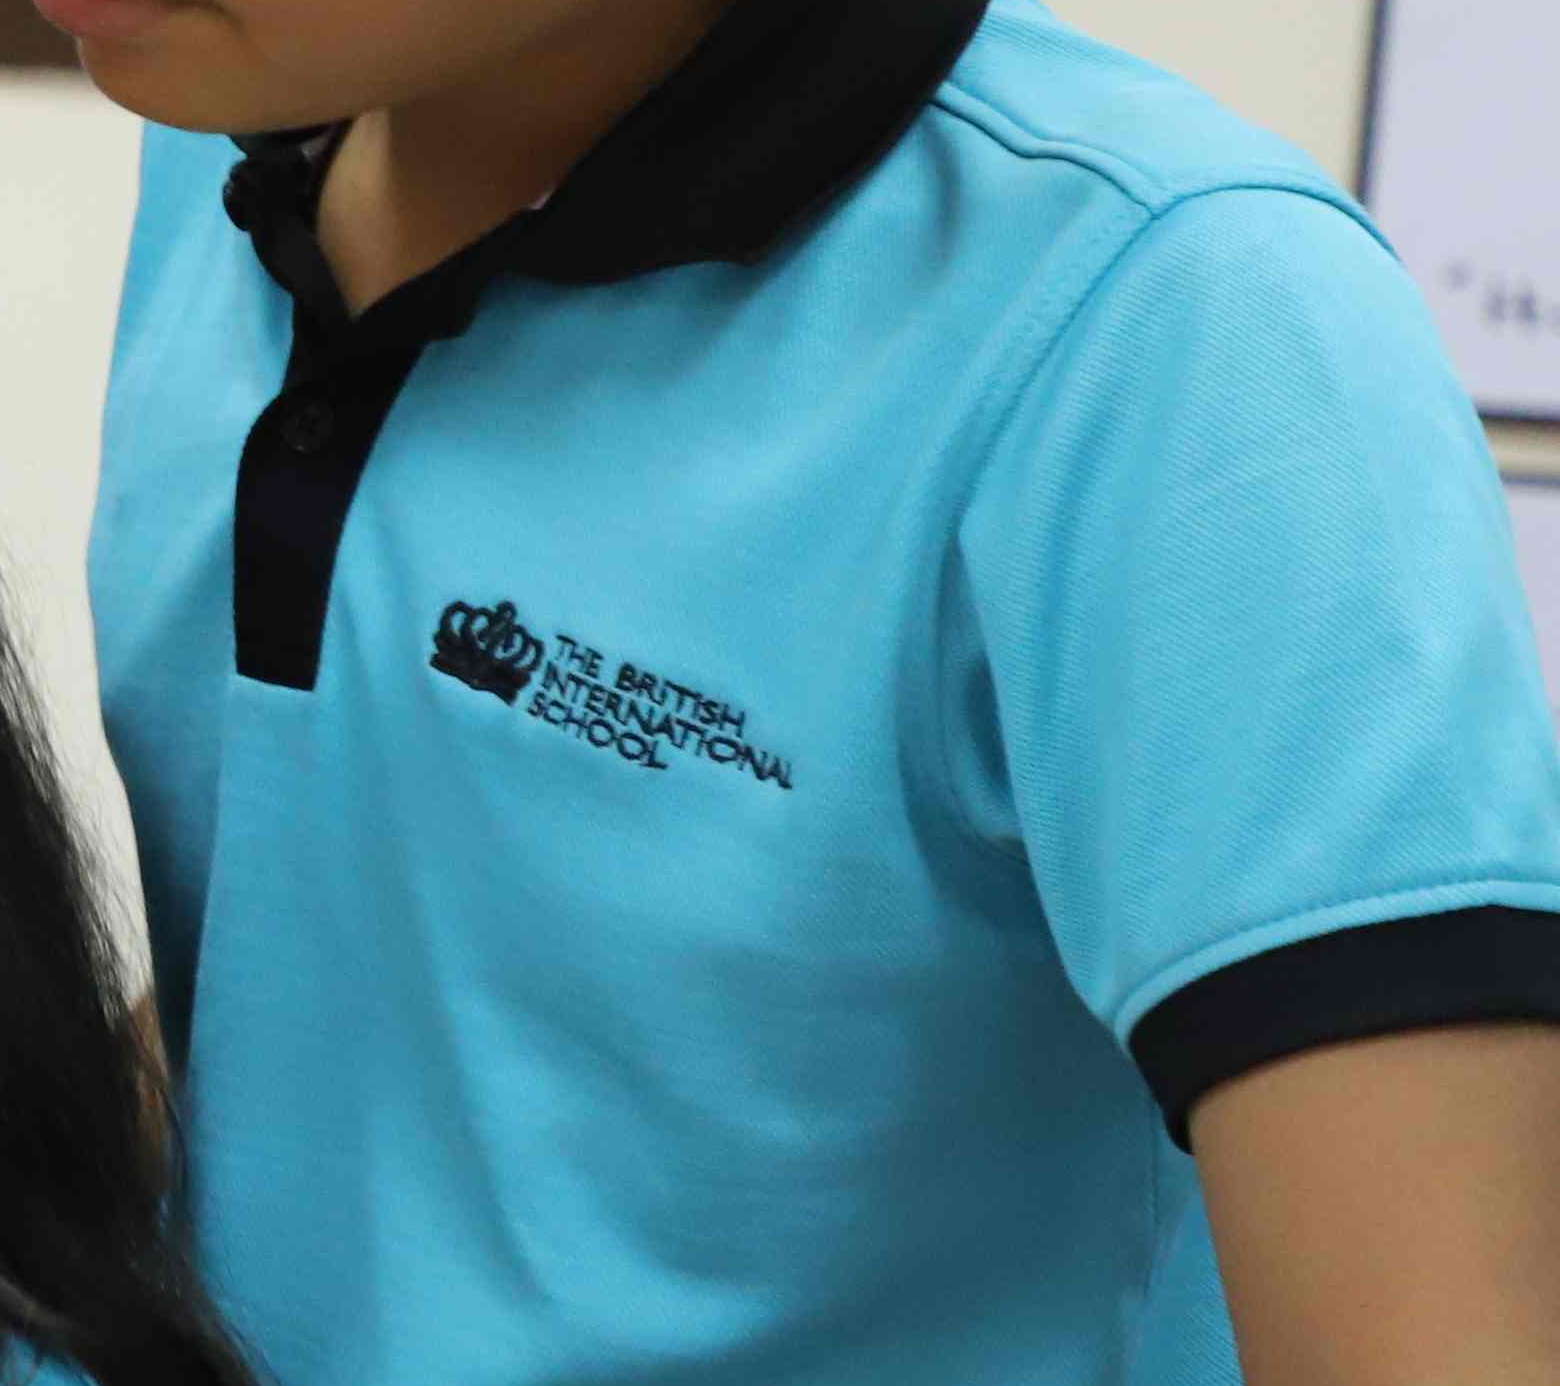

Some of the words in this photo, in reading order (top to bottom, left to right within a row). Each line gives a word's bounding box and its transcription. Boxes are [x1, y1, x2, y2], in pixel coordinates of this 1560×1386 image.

[525, 688, 670, 770] SCHOOL
[540, 660, 794, 791] INTERNATIONAL
[554, 632, 605, 680] THE
[615, 661, 748, 739] BRITISH
